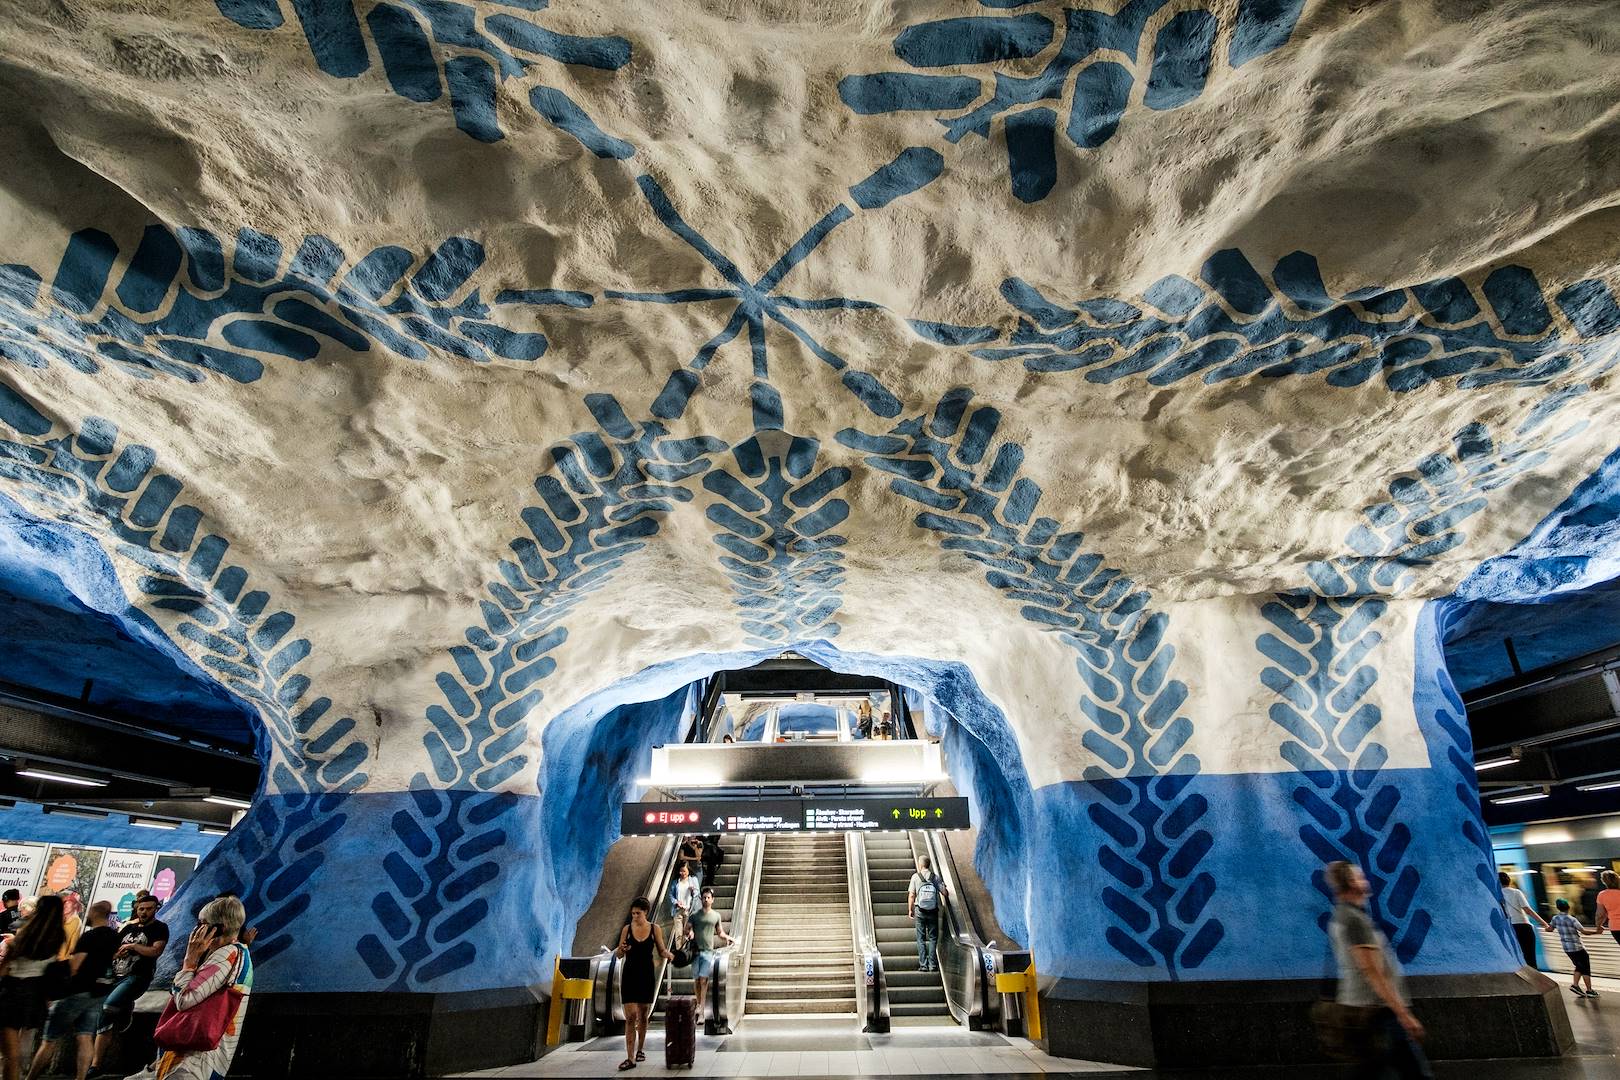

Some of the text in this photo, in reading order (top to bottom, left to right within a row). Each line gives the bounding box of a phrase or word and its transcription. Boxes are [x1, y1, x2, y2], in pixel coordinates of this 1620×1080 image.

[670, 813, 685, 823] upp
[909, 808, 926, 819] Upp
[18, 854, 31, 863] för
[108, 860, 142, 869] Böcker för
[102, 880, 114, 888] alla
